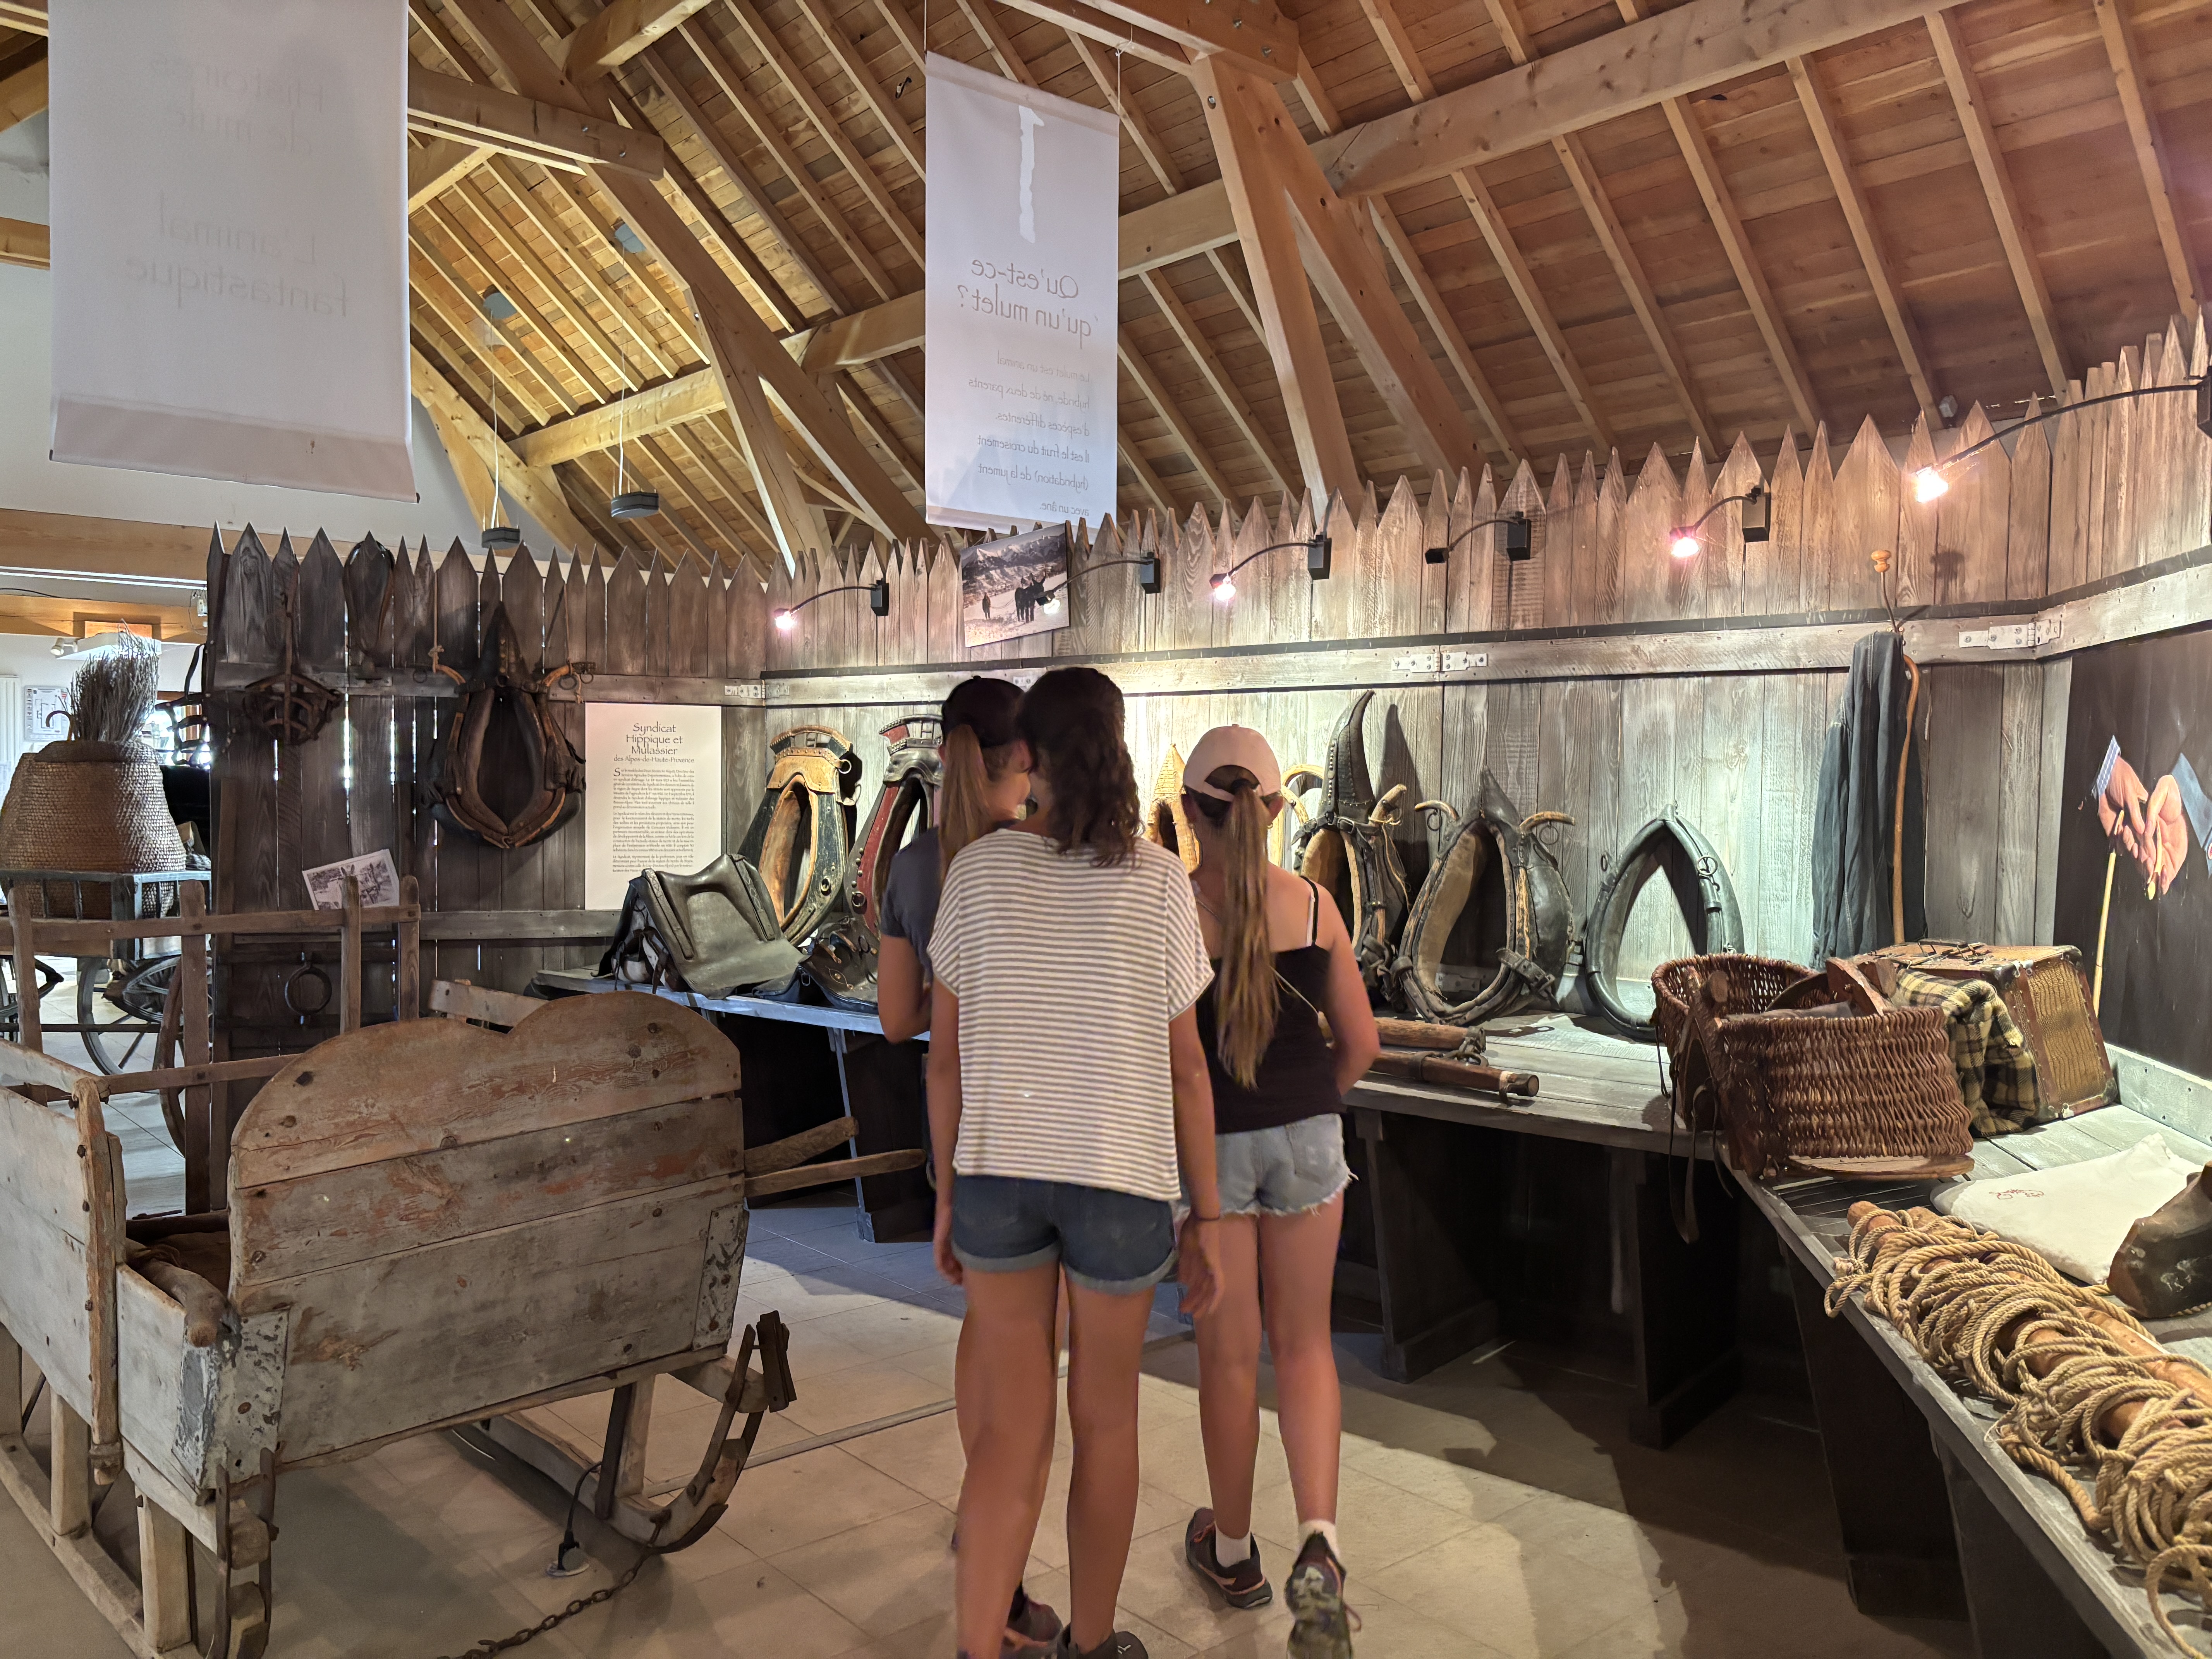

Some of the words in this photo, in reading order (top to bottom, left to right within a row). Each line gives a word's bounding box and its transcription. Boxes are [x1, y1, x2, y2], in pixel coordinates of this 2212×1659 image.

[632, 721, 677, 735] Syndicat
[626, 734, 671, 749] Hippique
[673, 736, 684, 744] et
[631, 746, 678, 755] Mulassier
[625, 755, 694, 764] Alpes-de-Haute-Provence
